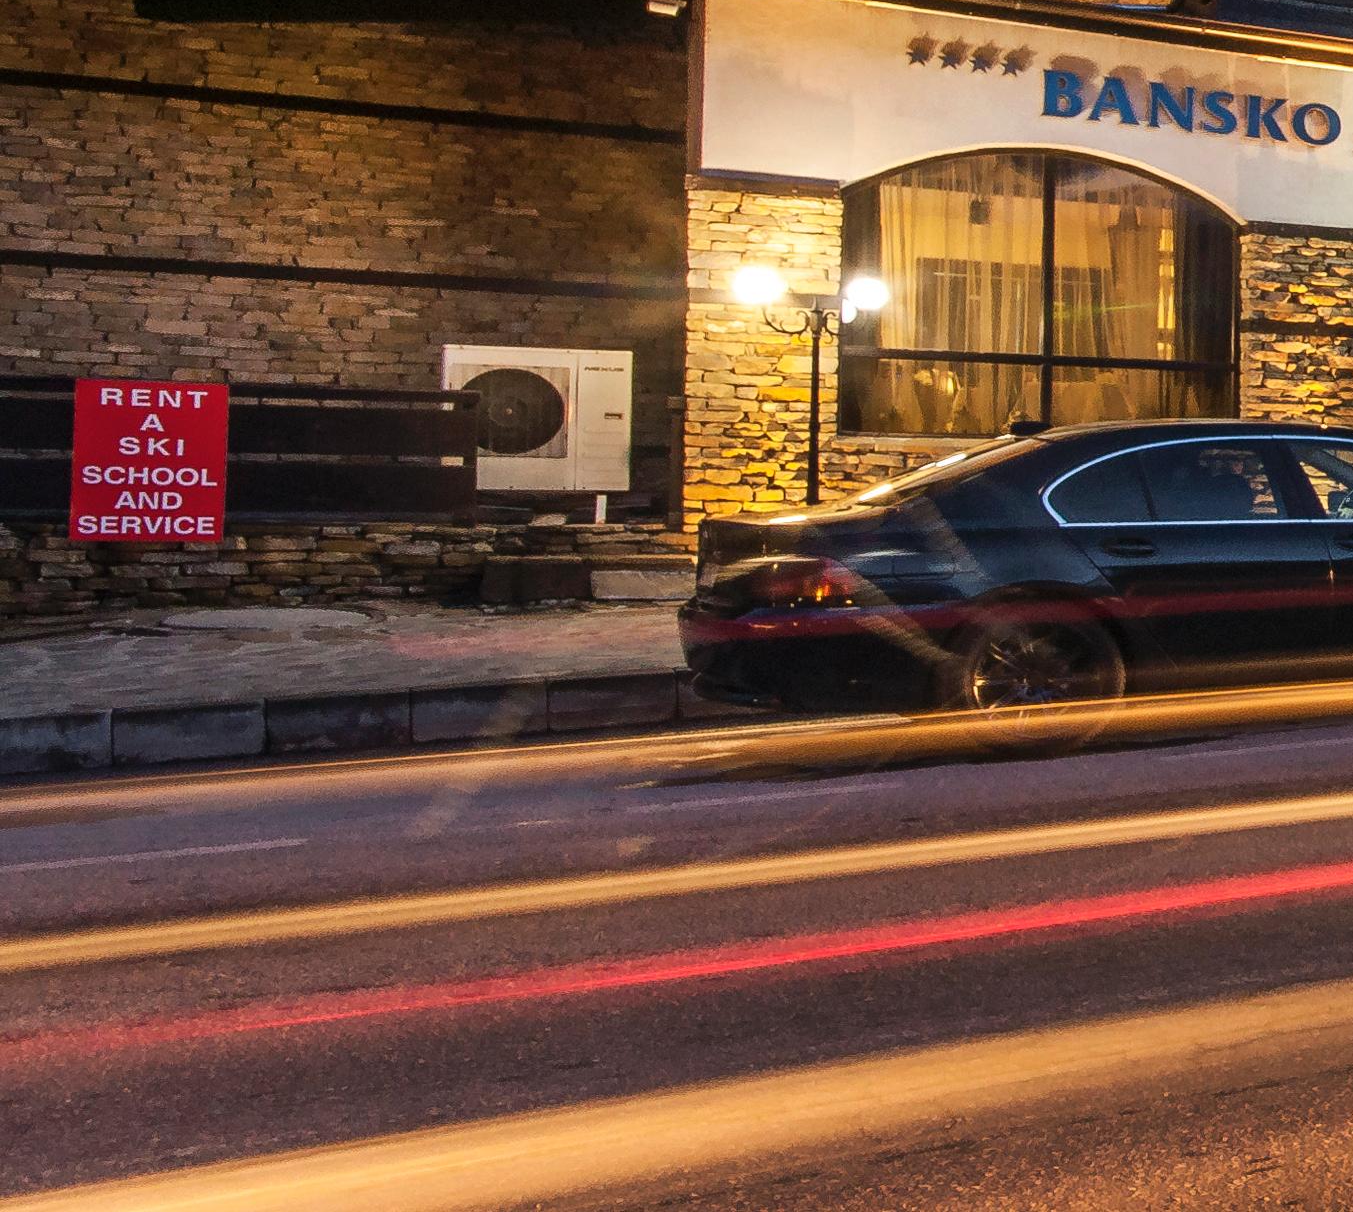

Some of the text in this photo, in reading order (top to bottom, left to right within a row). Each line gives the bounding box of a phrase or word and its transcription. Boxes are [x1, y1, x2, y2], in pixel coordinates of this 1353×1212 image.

[1041, 69, 1342, 146] BANSKO
[101, 388, 208, 409] RENT
[140, 414, 165, 432] A
[119, 437, 184, 456] SKI
[82, 466, 217, 486] SCHOOL
[115, 491, 183, 510] AND
[78, 516, 215, 535] SERVICE
